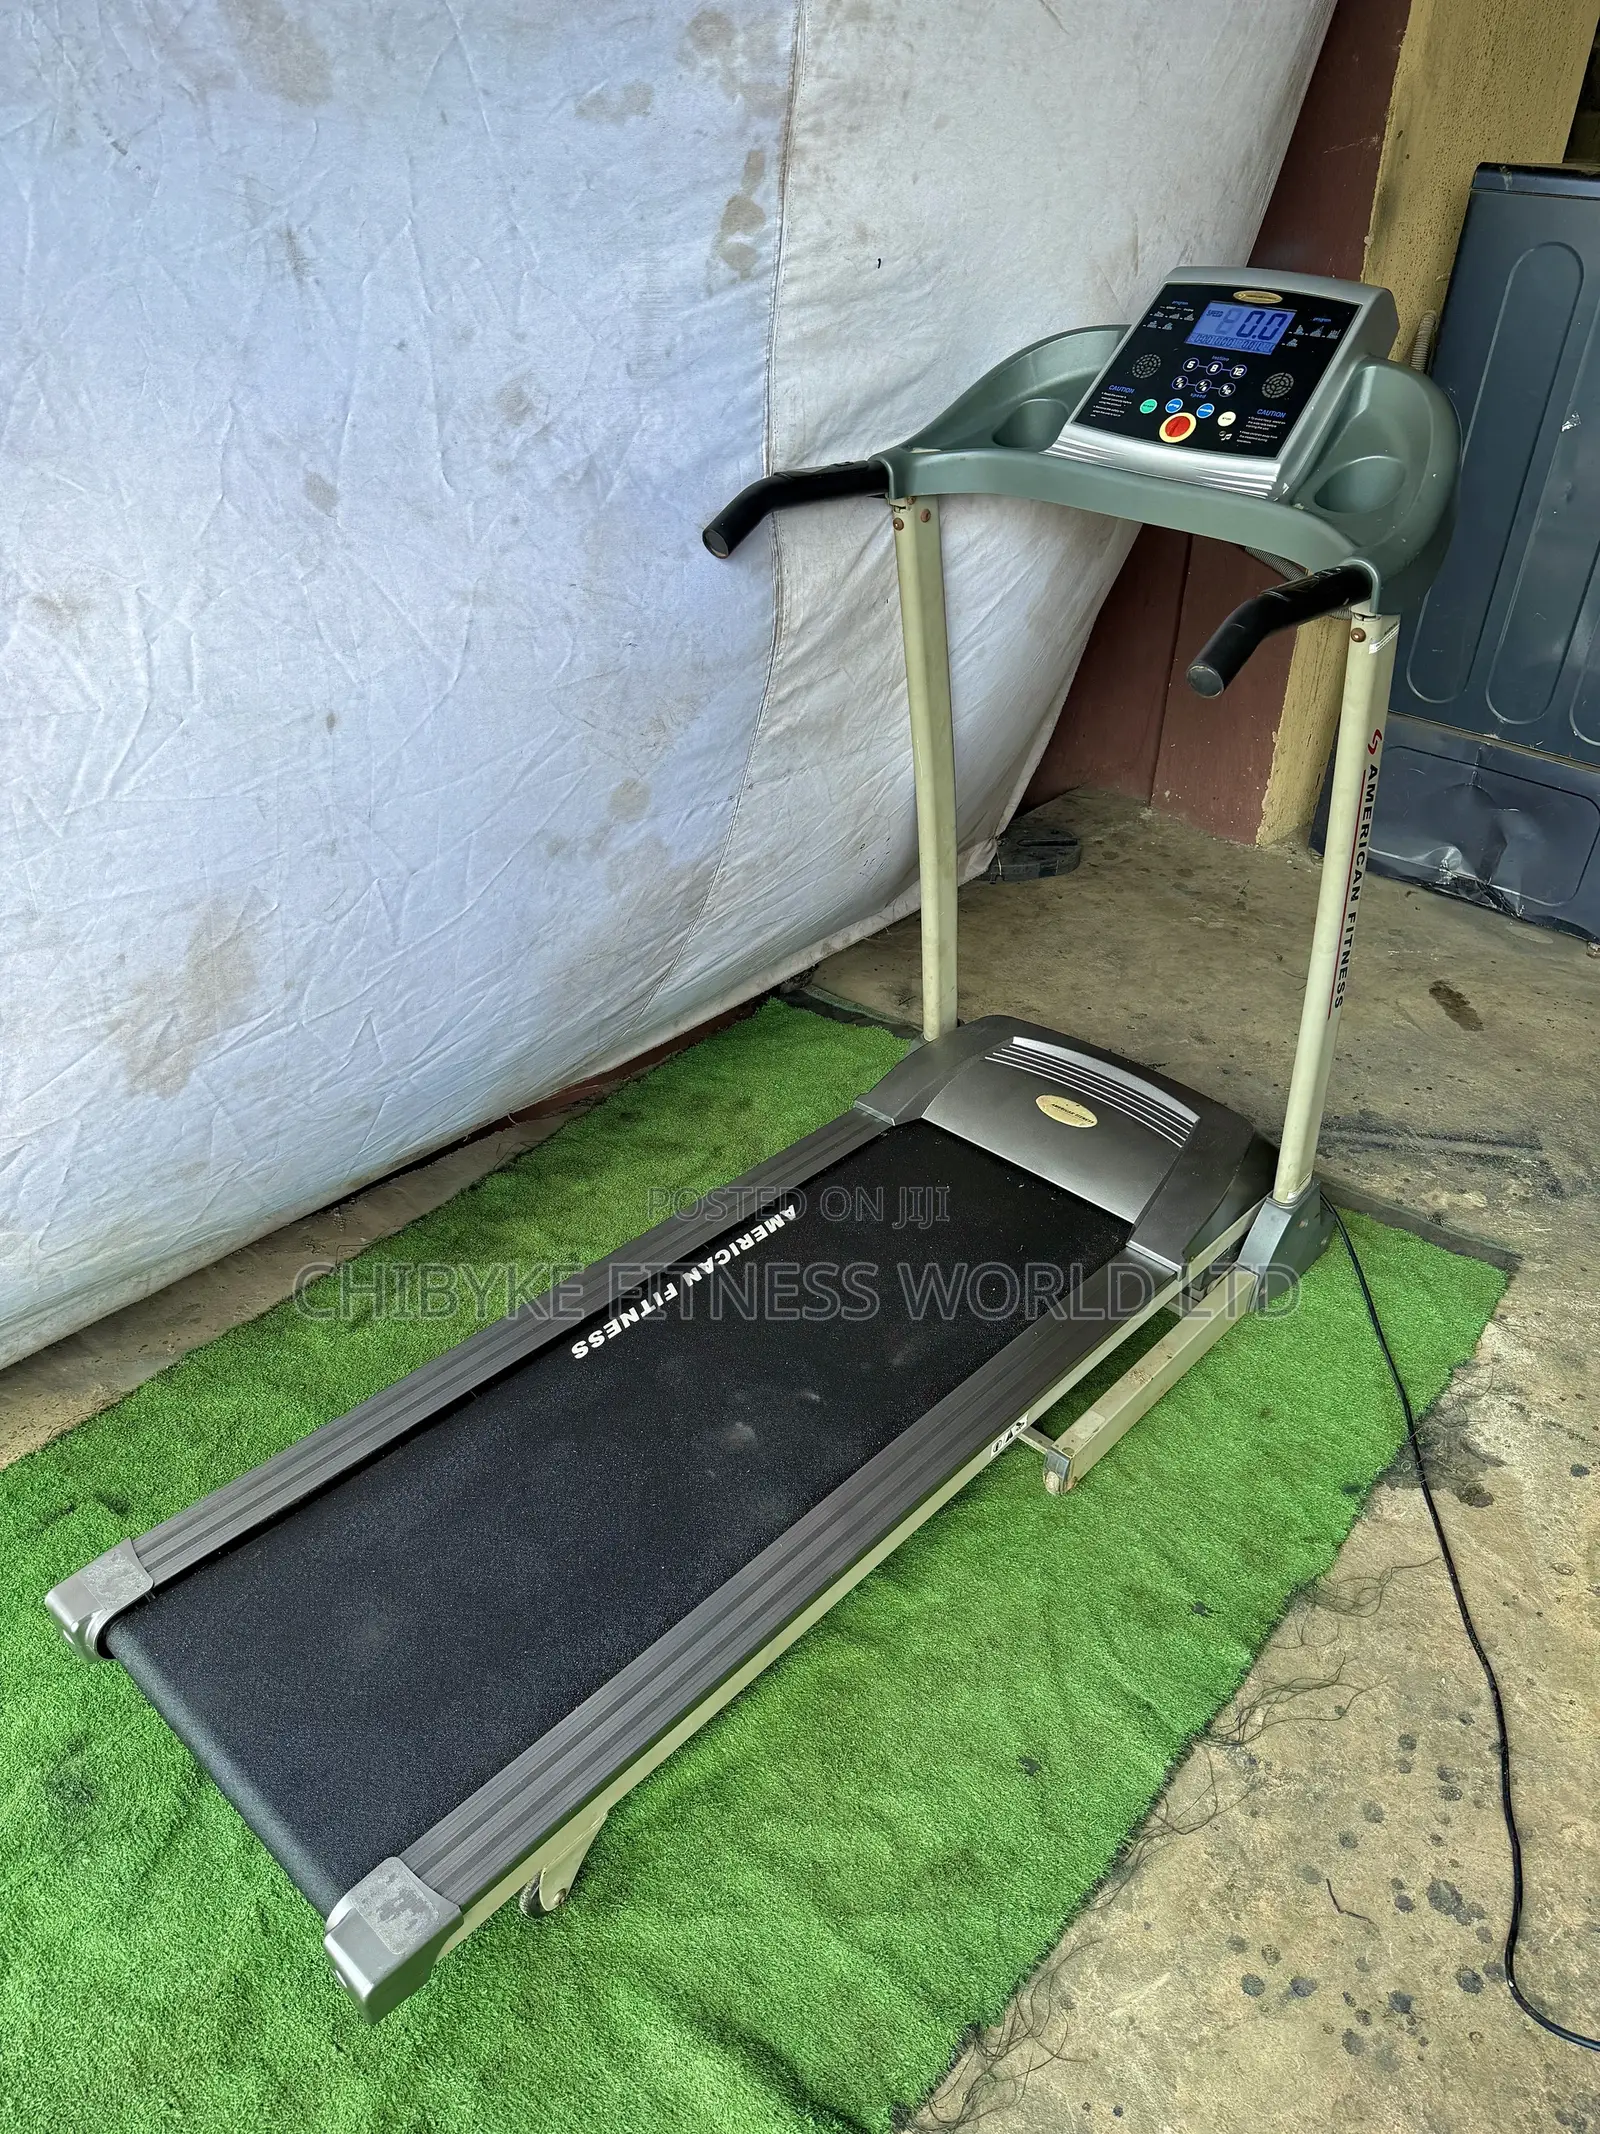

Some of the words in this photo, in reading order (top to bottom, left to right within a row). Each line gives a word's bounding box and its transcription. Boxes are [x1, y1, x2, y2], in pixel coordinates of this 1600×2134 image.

[1206, 309, 1224, 318] SPEED
[1236, 310, 1288, 341] 0.0
[1186, 360, 1196, 369] 6
[1209, 364, 1219, 372] 8
[1232, 367, 1244, 376] 12
[1108, 384, 1135, 394] CAUTION
[1256, 408, 1287, 418] CAUTION
[1350, 764, 1379, 902] AMERICAN
[1334, 911, 1357, 1009] FITNESS
[682, 1204, 797, 1288] AMERICAN
[571, 1282, 679, 1360] FITNESS
